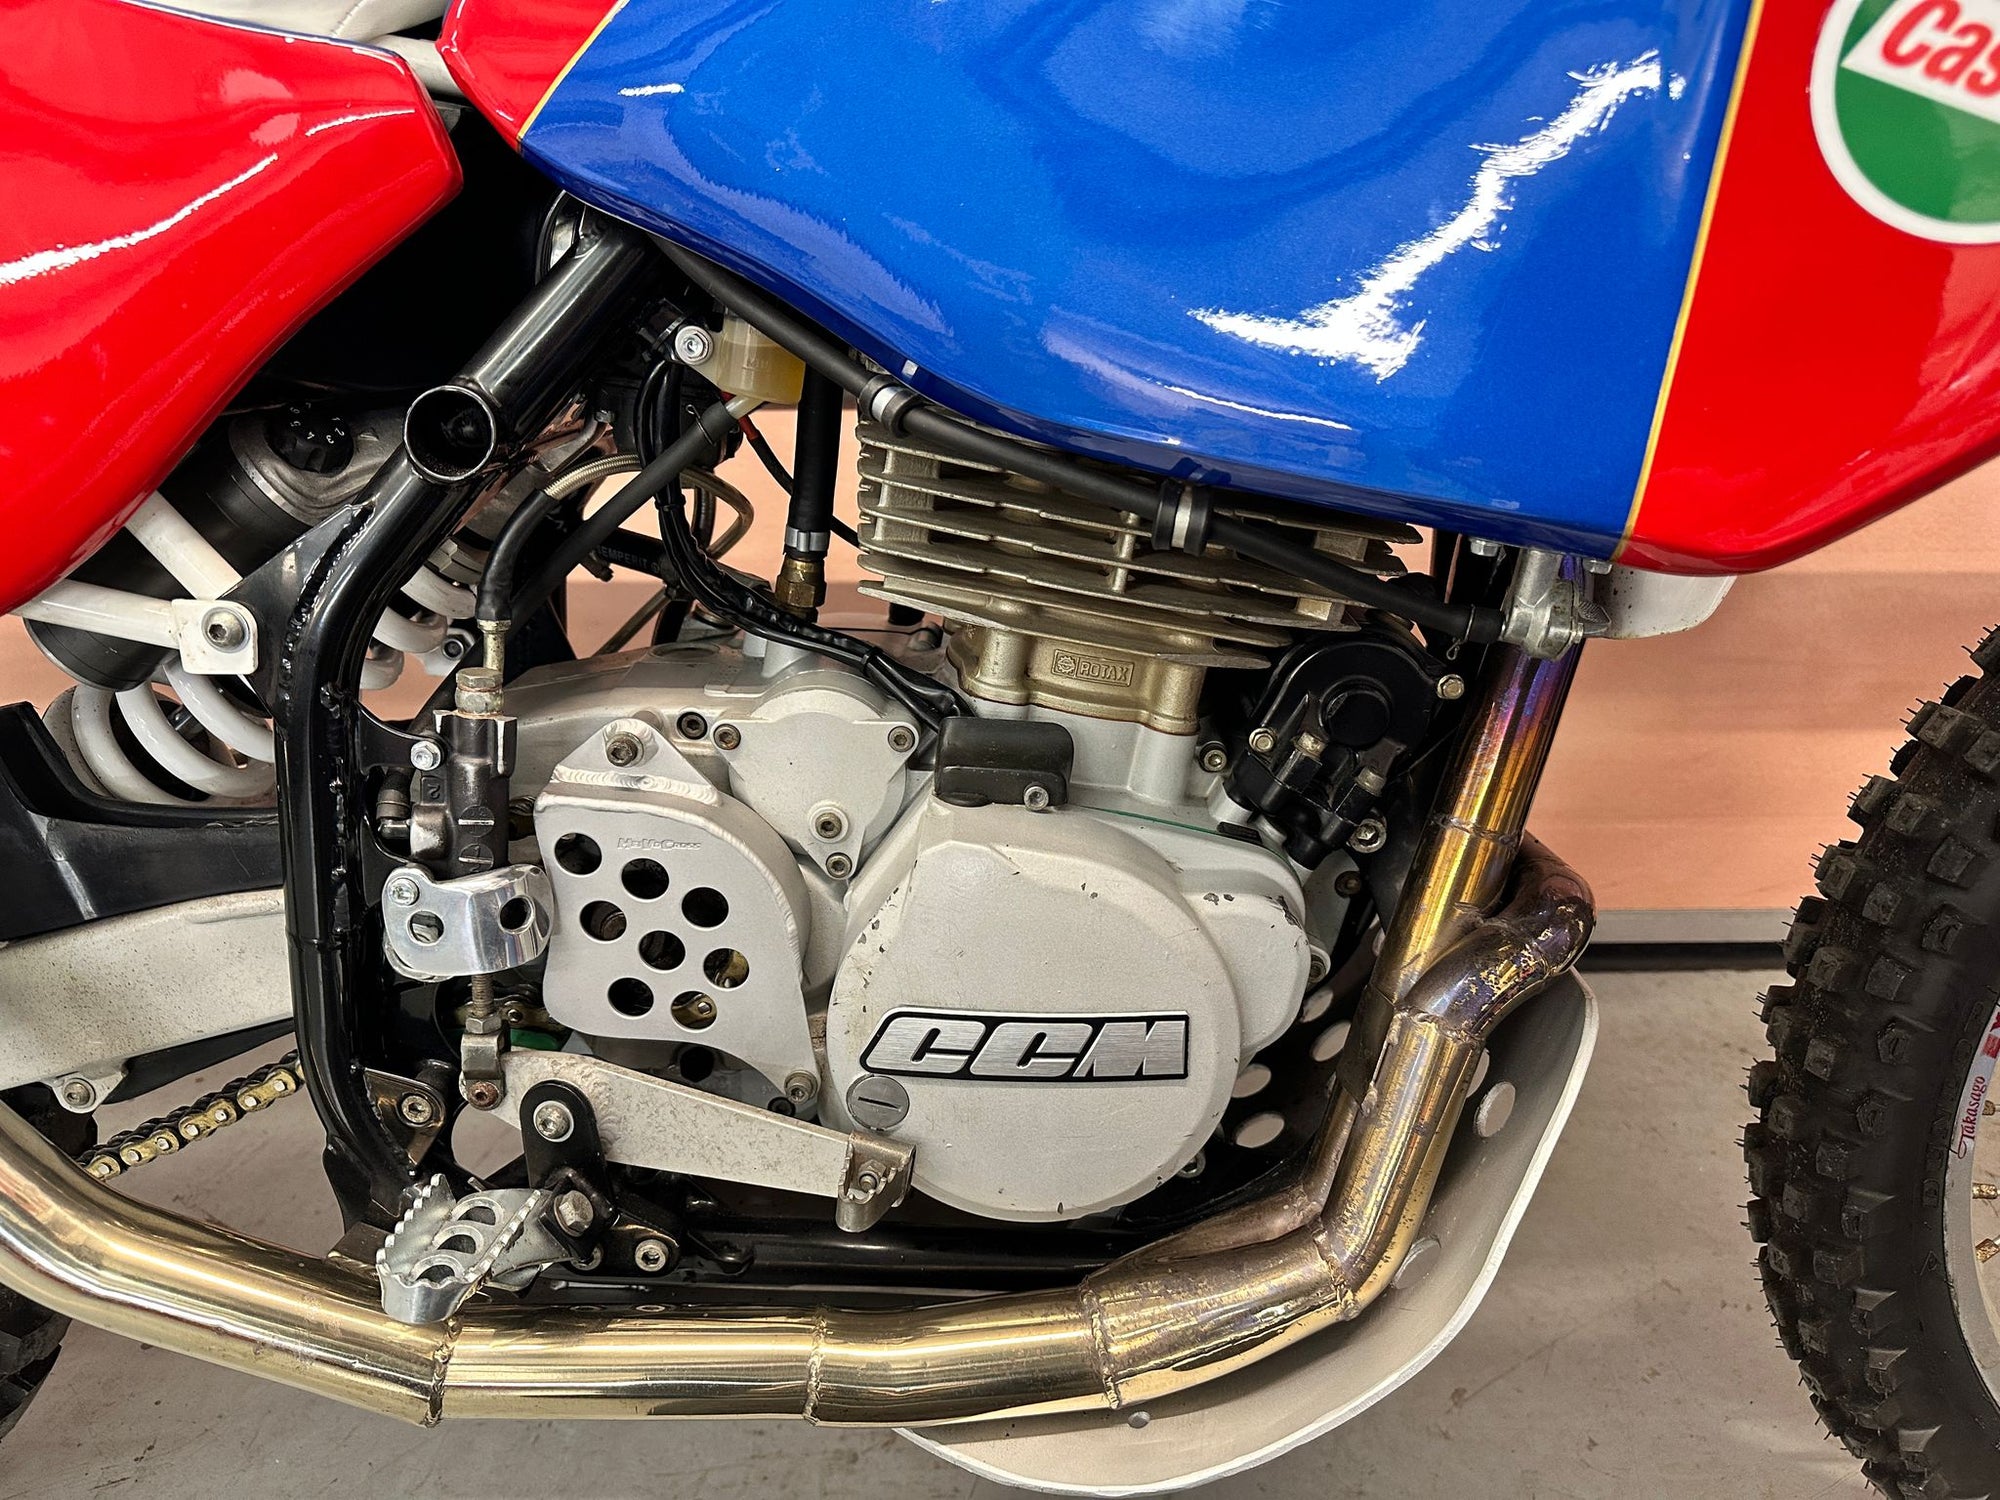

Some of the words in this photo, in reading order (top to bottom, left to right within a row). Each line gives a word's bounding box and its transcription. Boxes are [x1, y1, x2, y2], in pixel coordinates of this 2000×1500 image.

[1079, 660, 1129, 681] ROTAX
[865, 1013, 1186, 1078] CCM
[1956, 1075, 1987, 1159] Takasago
